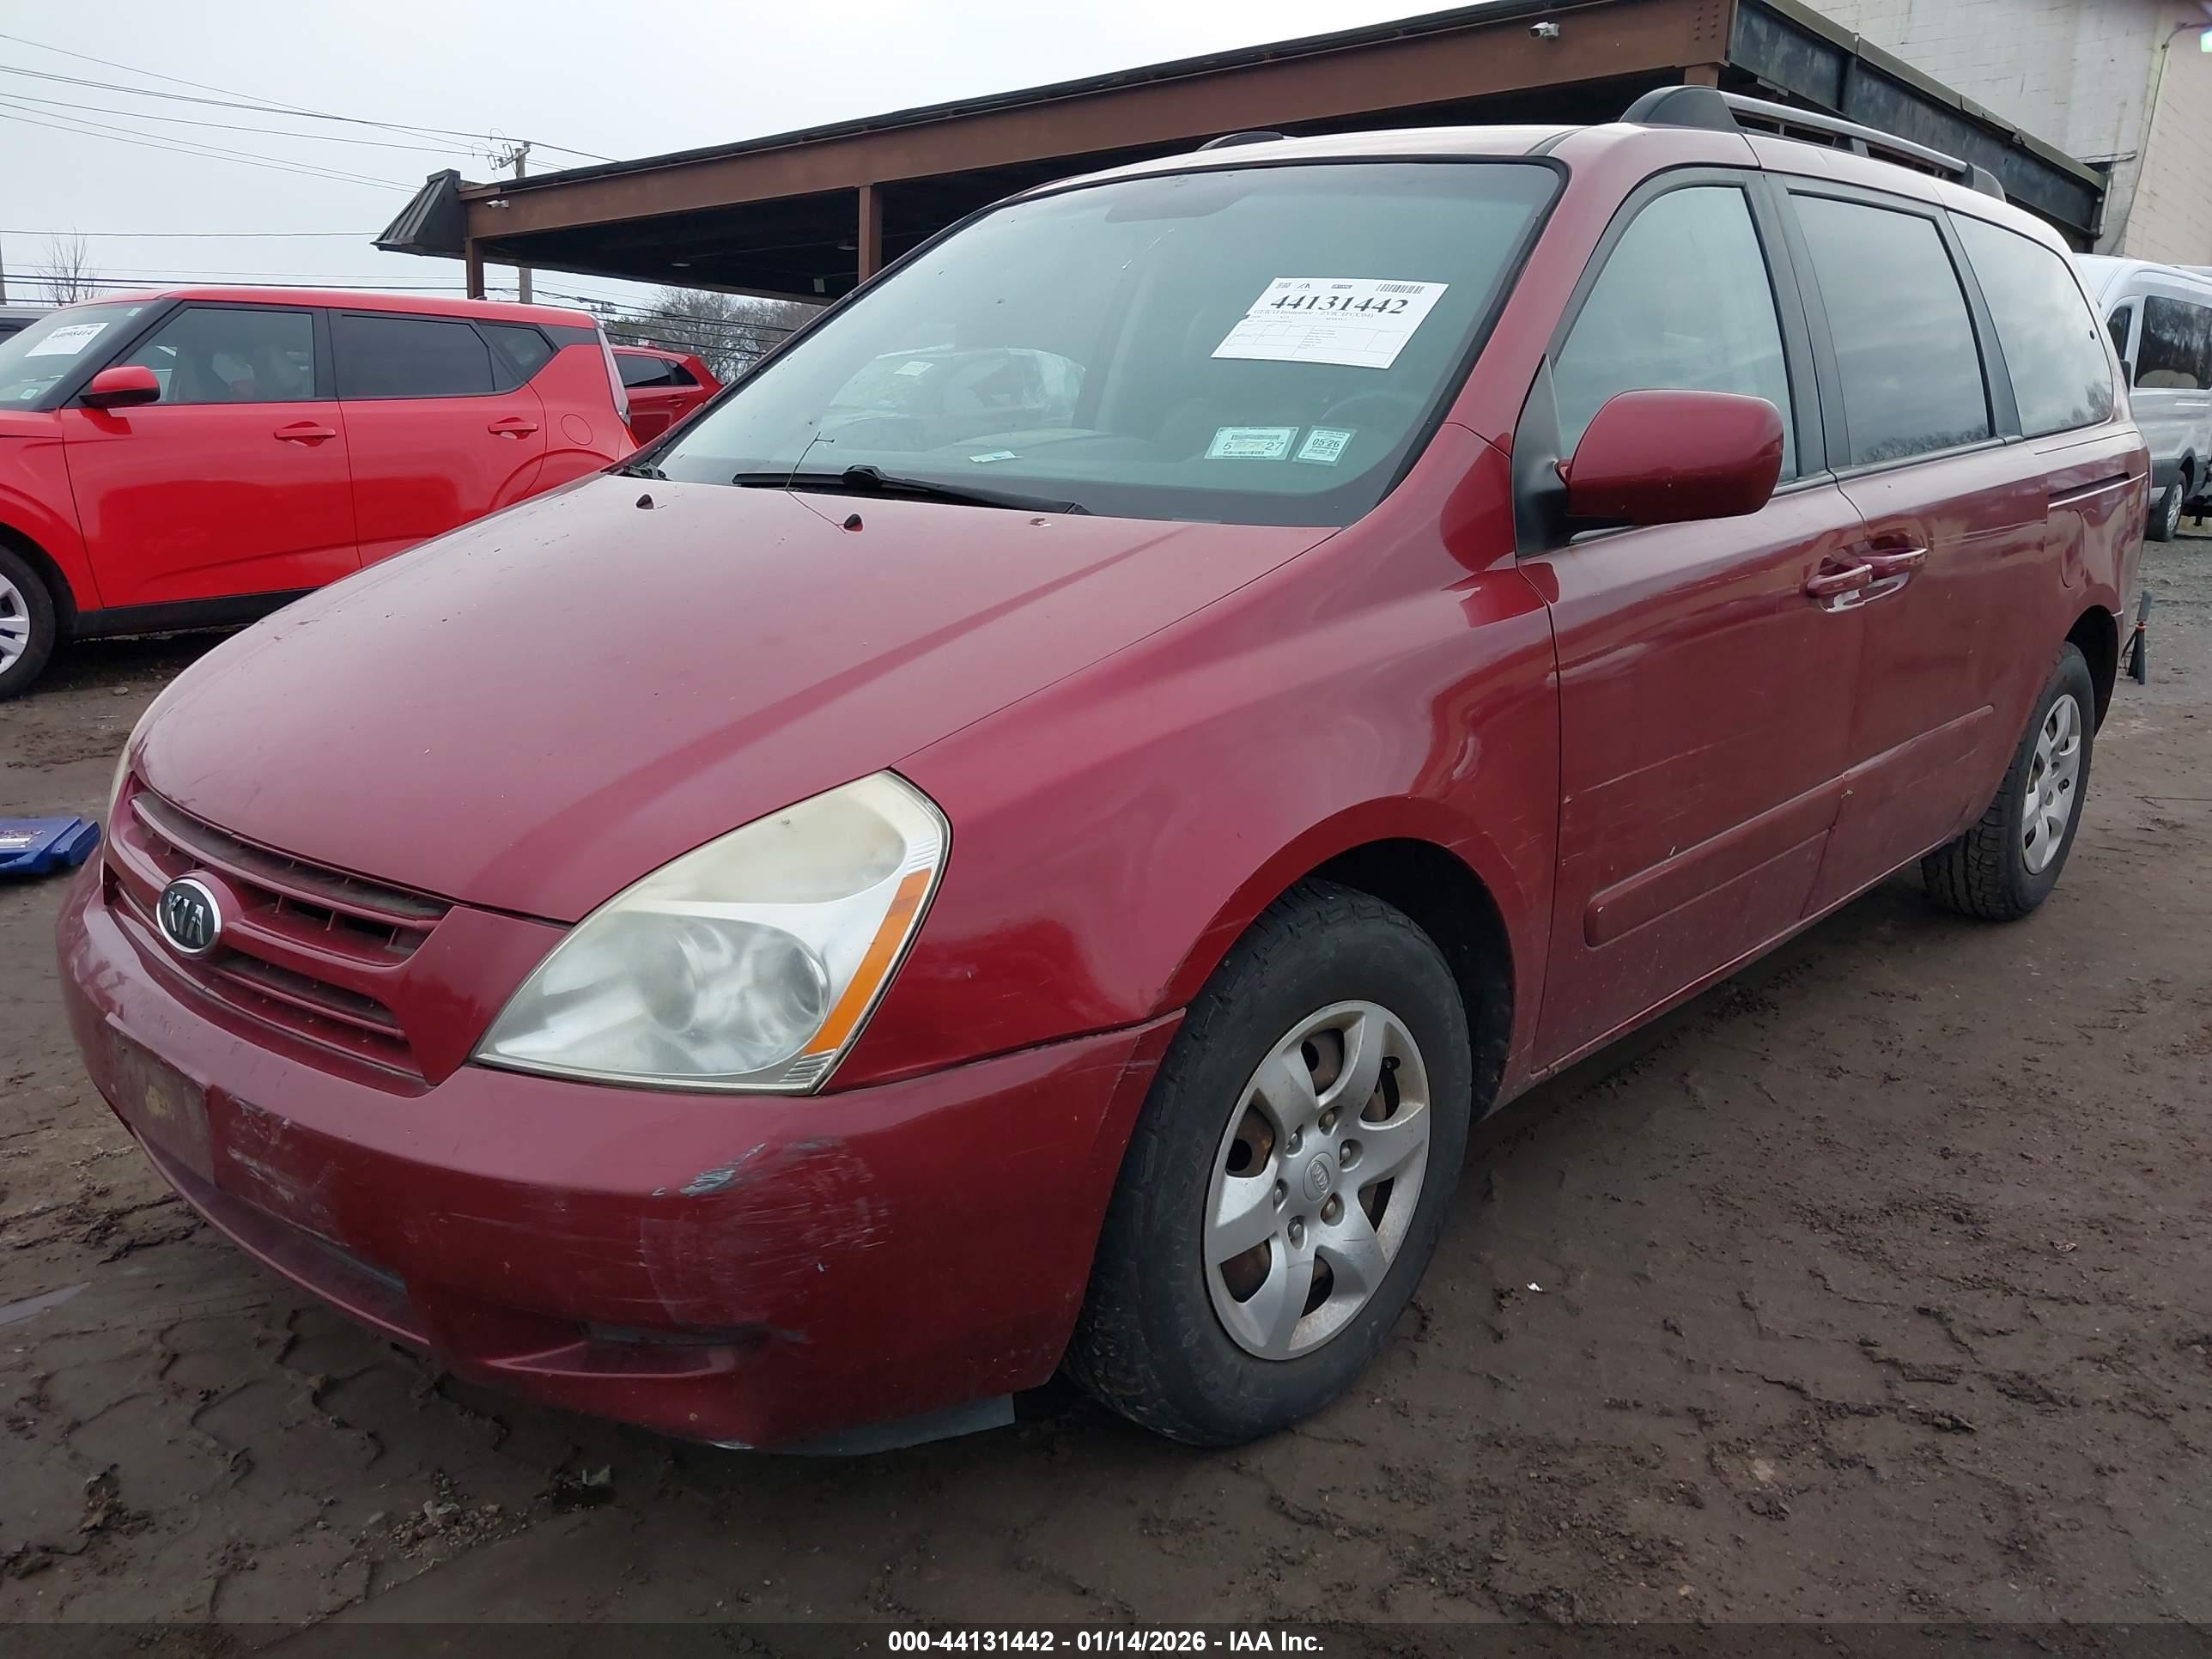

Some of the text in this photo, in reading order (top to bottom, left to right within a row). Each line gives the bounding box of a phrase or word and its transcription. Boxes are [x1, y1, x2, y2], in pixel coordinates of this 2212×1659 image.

[1271, 295, 1408, 314] 44131442
[1223, 441, 1285, 451] 5 27
[164, 890, 204, 945] KIA
